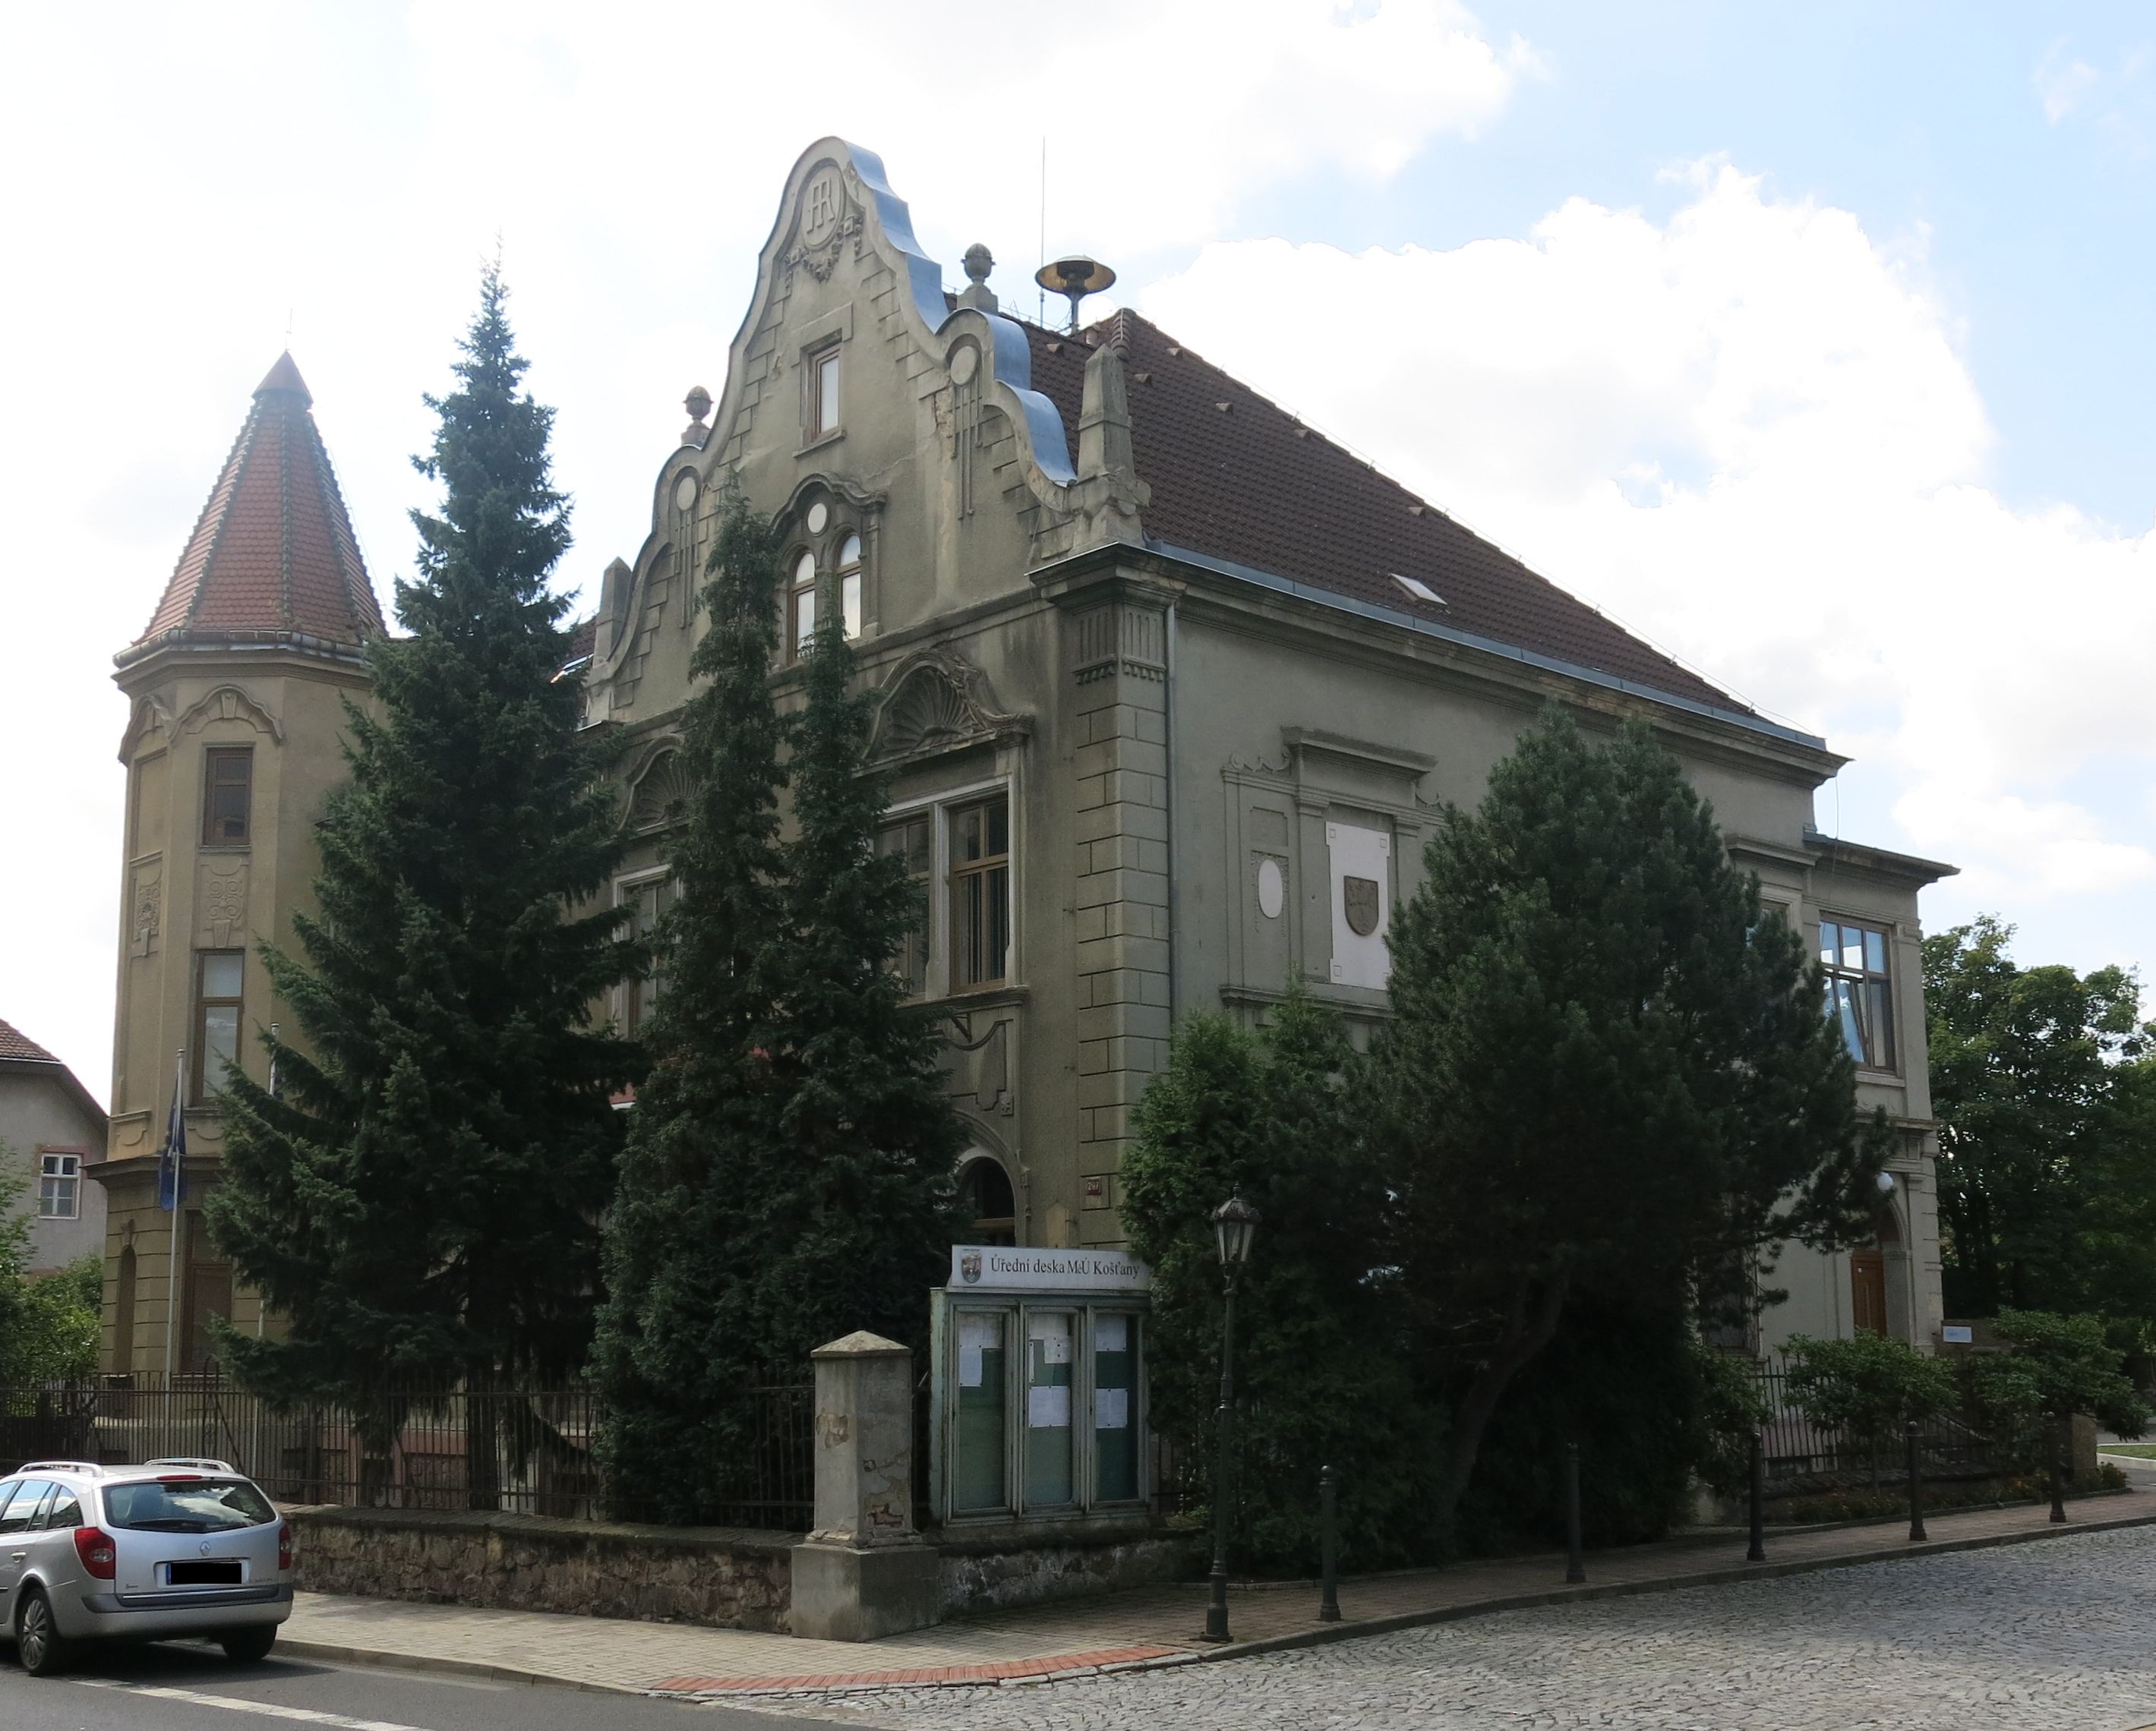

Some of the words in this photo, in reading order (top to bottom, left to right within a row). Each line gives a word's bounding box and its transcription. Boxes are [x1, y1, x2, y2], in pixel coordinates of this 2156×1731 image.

[991, 1254, 1030, 1272] Úřední
[1034, 1259, 1065, 1274] deska
[1094, 1260, 1139, 1279] Košťany
